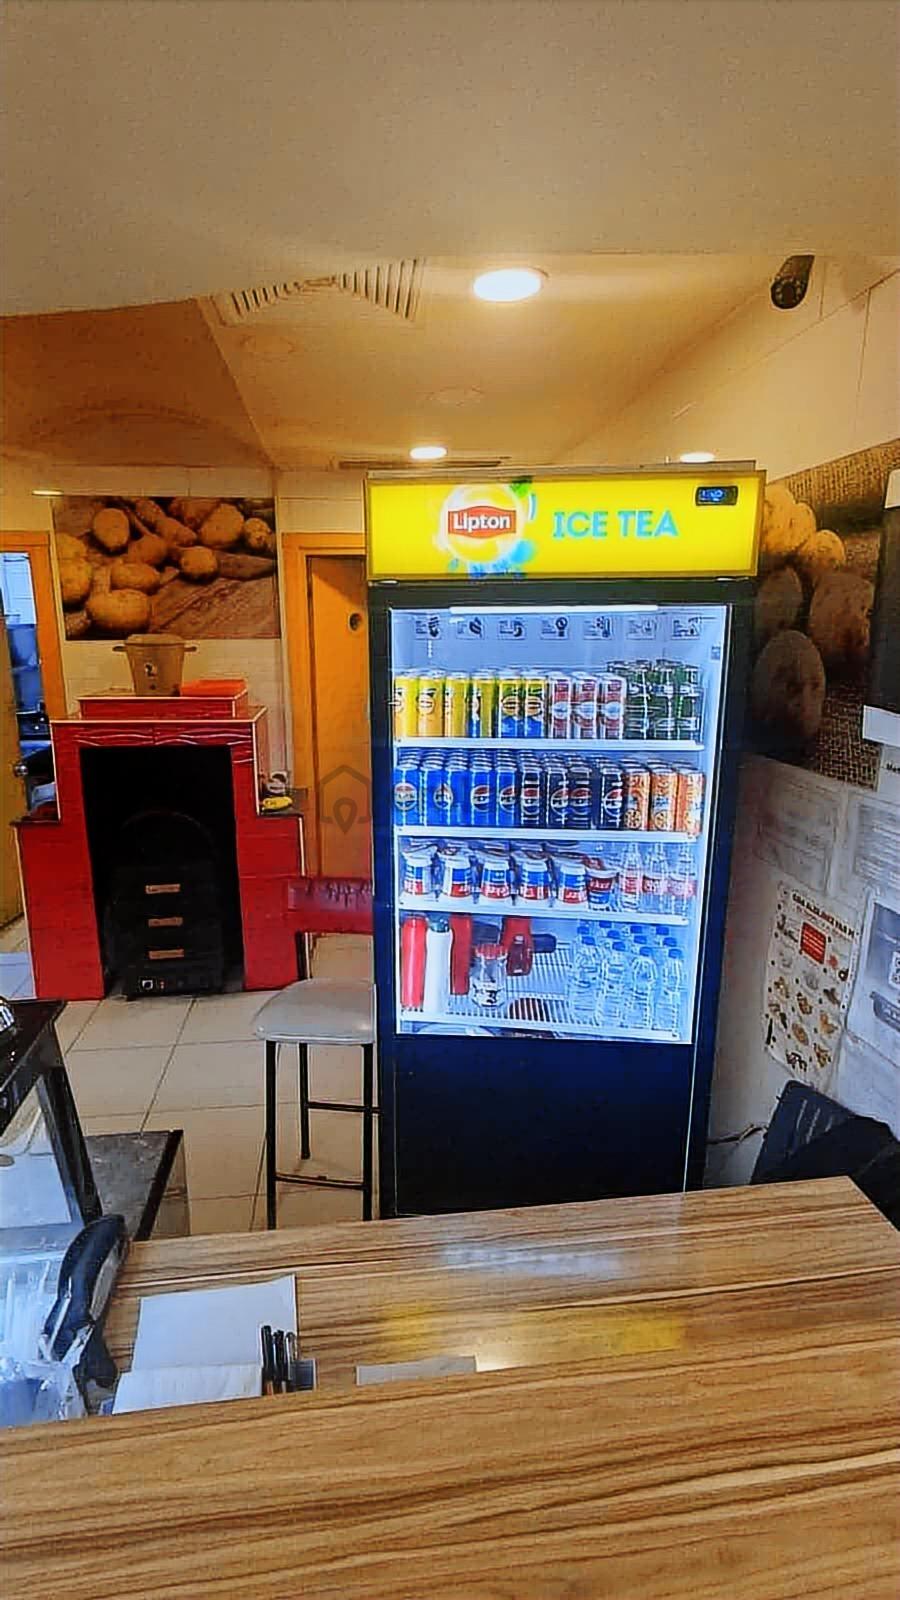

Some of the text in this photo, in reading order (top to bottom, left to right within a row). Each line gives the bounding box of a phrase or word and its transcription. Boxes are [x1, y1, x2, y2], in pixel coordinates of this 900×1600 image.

[453, 512, 511, 533] Lipton
[553, 510, 679, 538] ICE TEA
